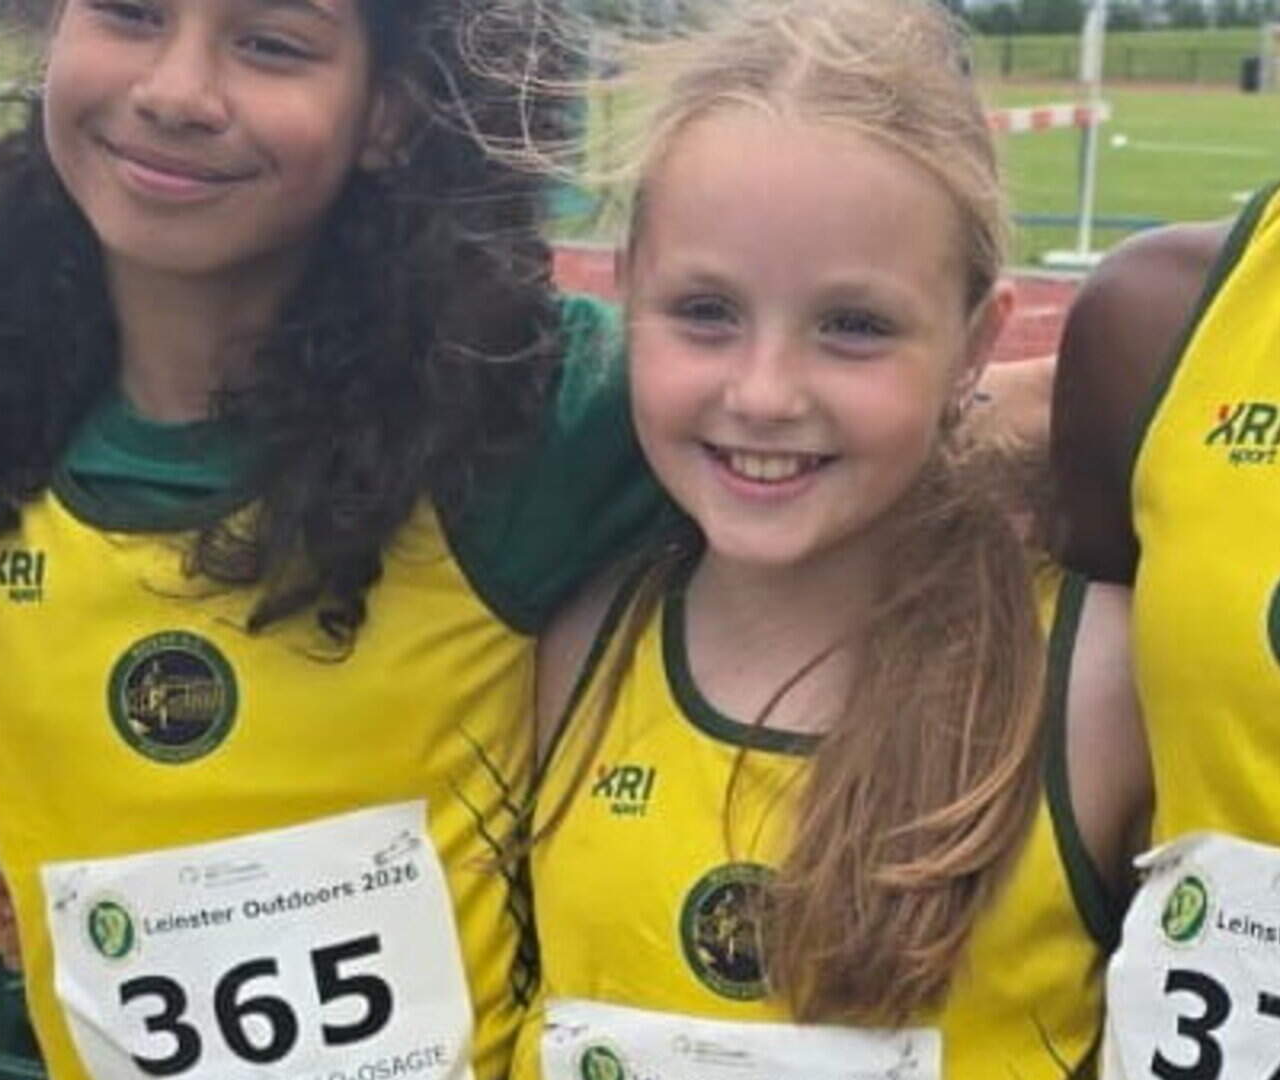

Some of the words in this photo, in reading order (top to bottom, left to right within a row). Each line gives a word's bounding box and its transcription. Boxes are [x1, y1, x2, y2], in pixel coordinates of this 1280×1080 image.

[144, 906, 233, 935] Leinster
[242, 880, 353, 919] Outdoors
[361, 863, 419, 892] 2026
[120, 934, 394, 1077] 365
